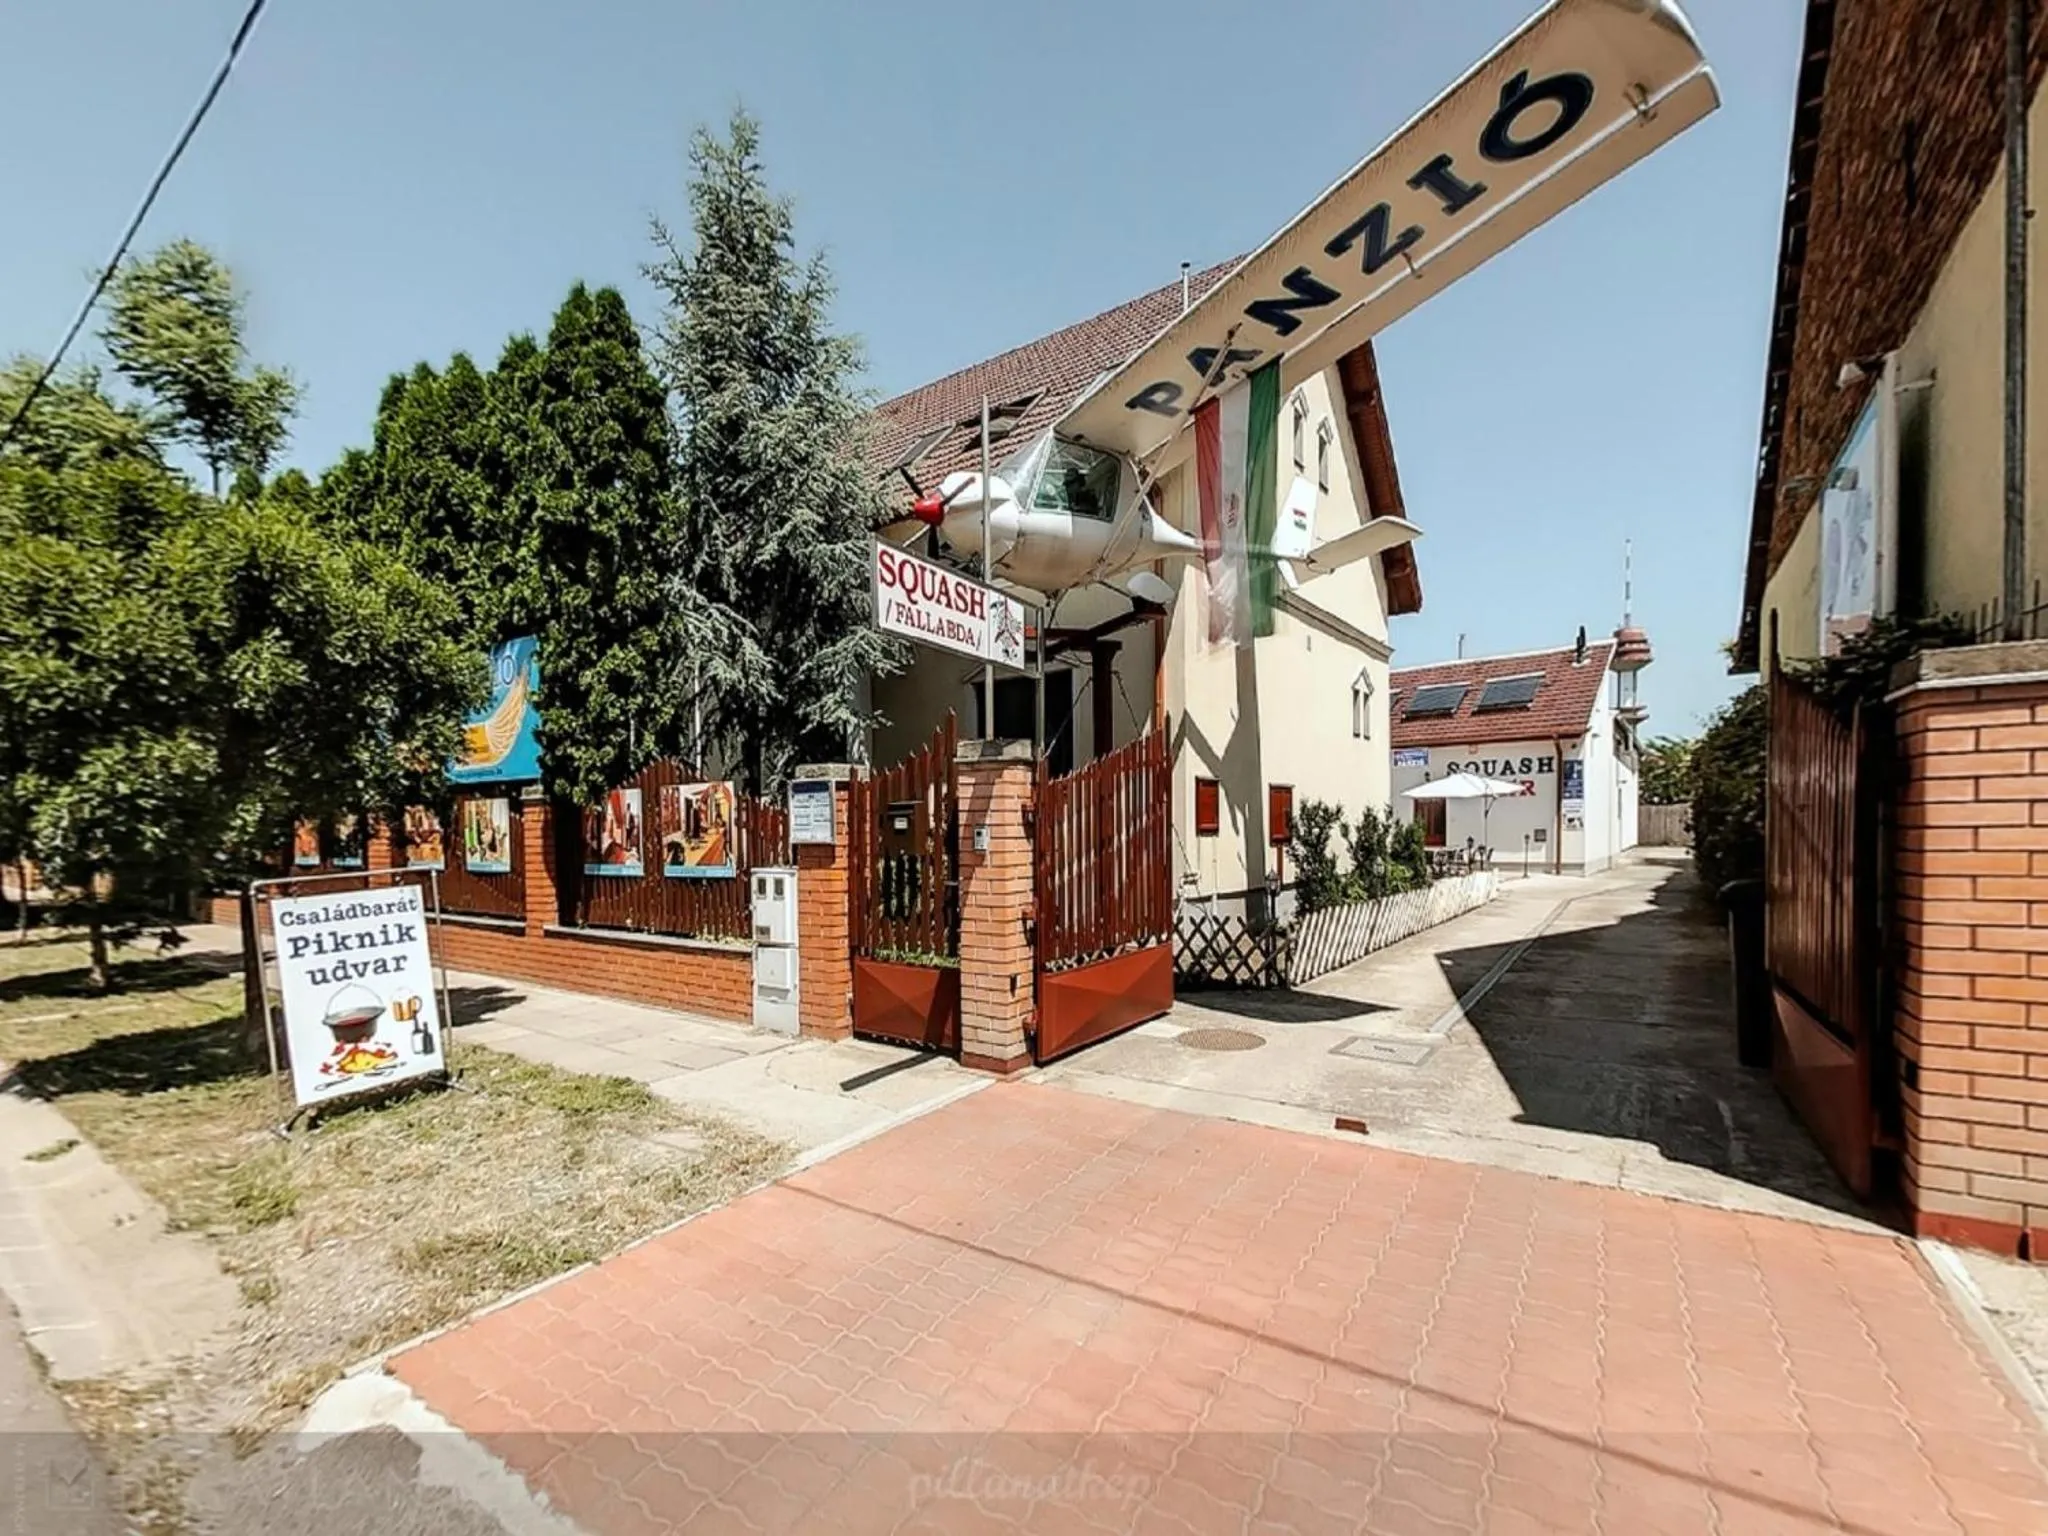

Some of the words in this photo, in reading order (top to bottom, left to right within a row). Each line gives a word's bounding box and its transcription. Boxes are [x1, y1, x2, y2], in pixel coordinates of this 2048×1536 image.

[1124, 69, 1595, 417] PANZIÓ
[879, 550, 986, 621] SQUASH
[1447, 756, 1554, 776] SQUASH
[280, 899, 417, 926] Családbarát
[287, 923, 417, 959] Piknik
[306, 954, 407, 985] udvar
